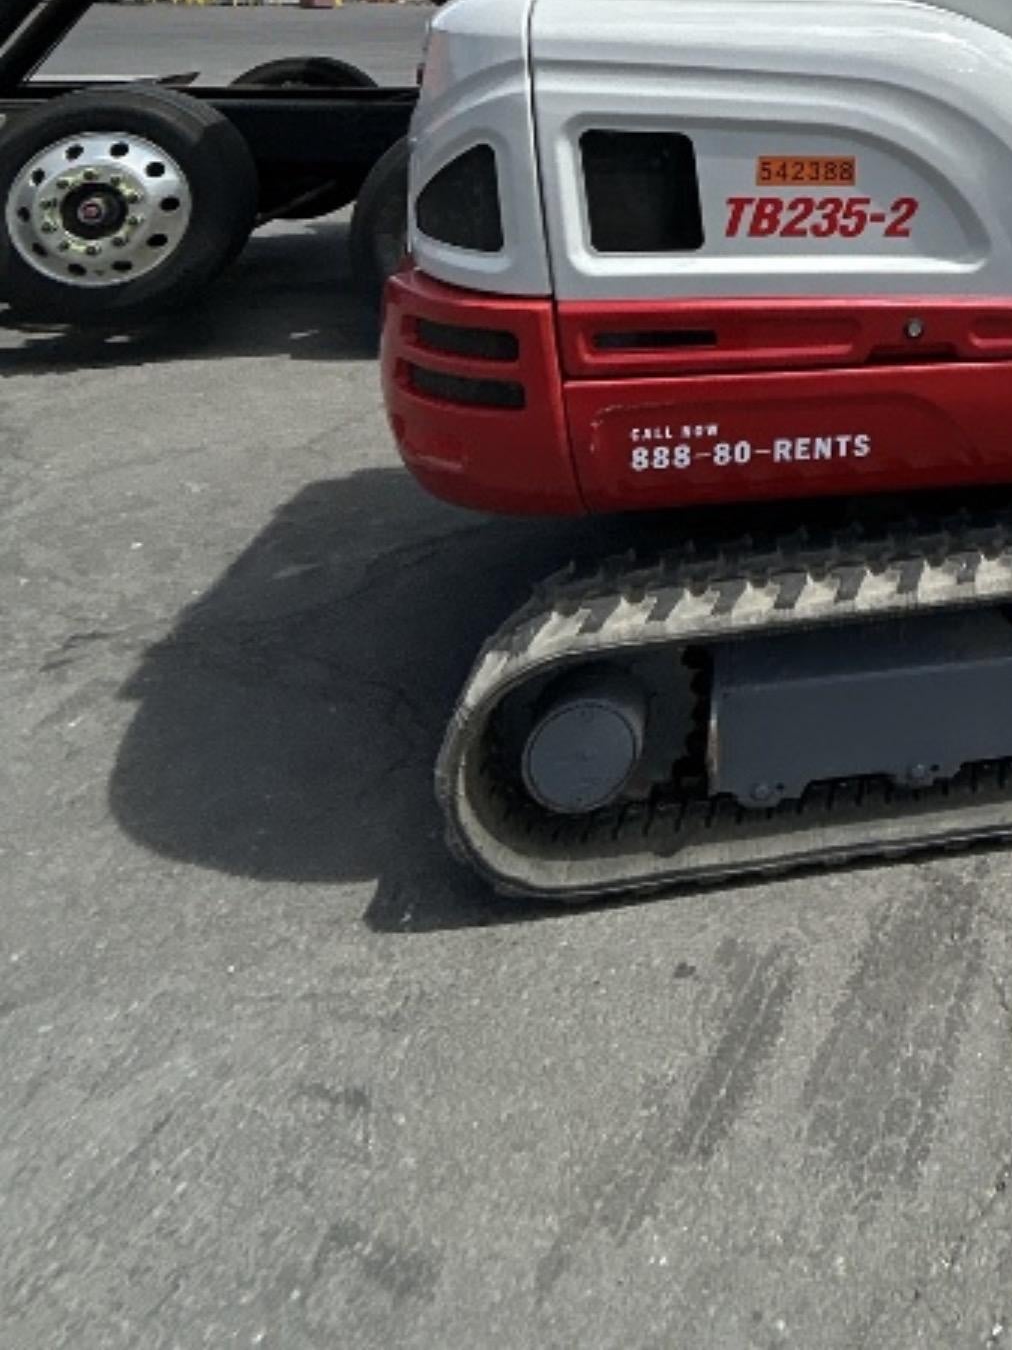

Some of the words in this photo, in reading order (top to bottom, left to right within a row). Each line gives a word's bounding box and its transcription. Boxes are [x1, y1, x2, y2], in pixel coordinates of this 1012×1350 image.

[759, 160, 853, 182] 542388
[725, 197, 919, 238] TB235-2
[630, 426, 673, 441] CALL
[681, 424, 718, 438] NOW
[631, 434, 871, 471] 888-80-RENTS
